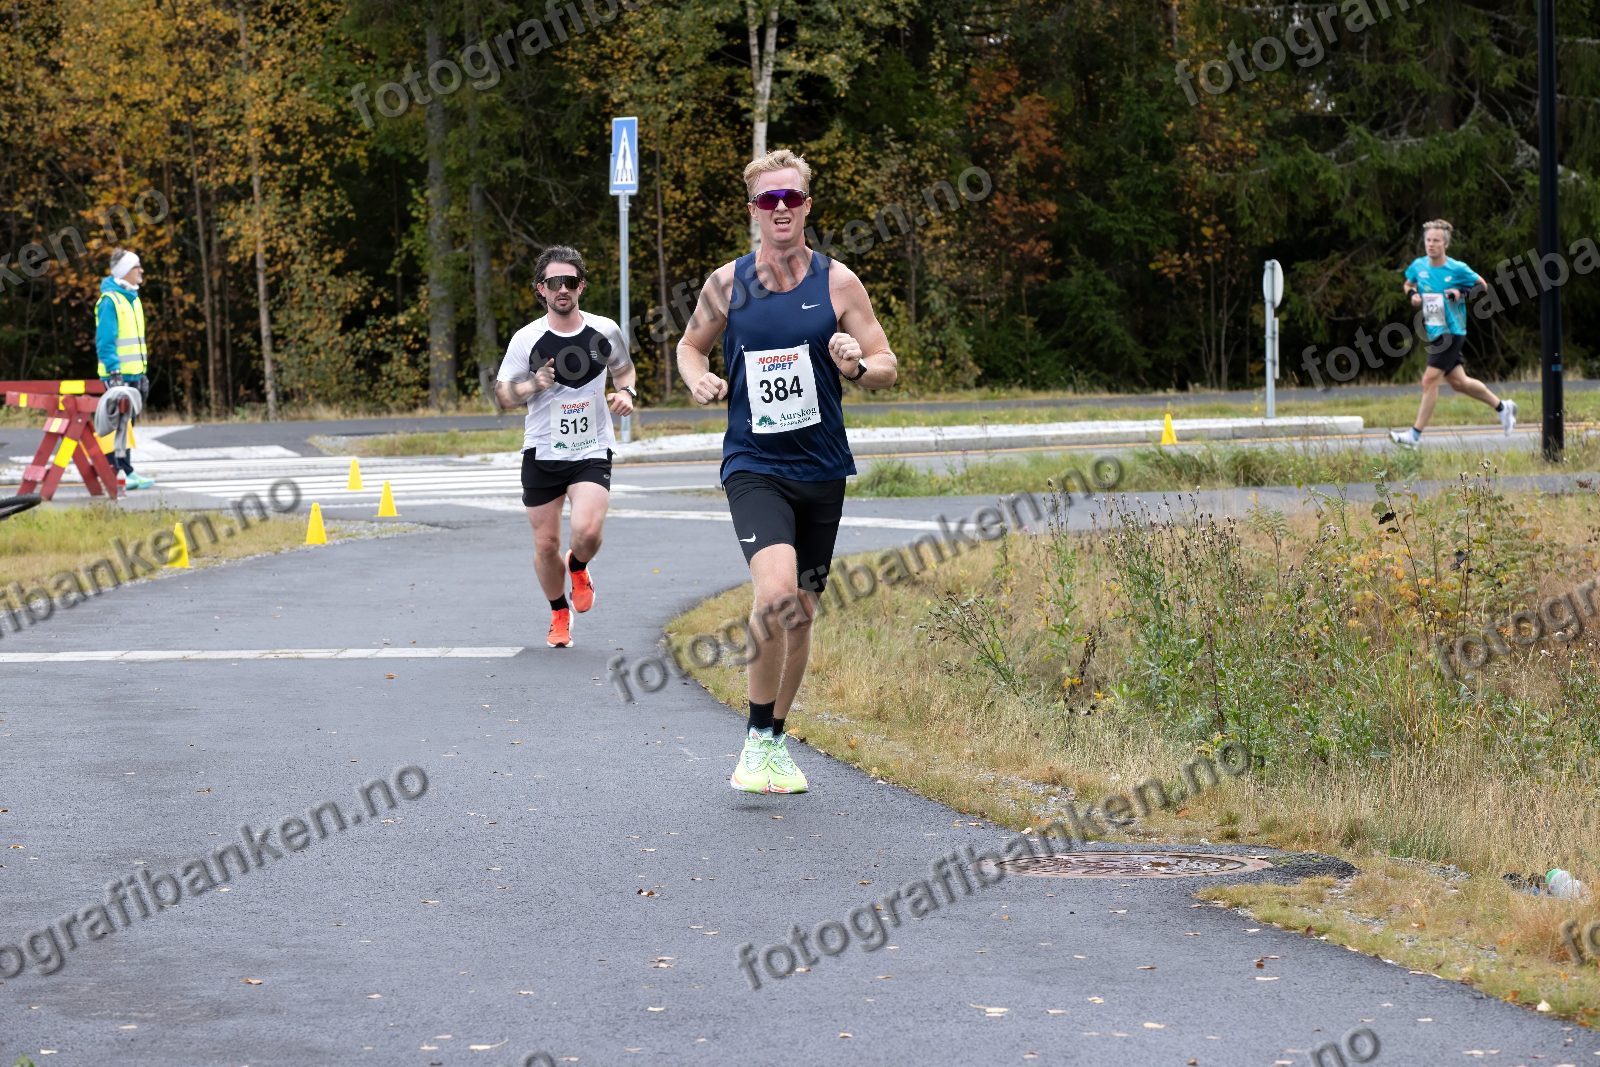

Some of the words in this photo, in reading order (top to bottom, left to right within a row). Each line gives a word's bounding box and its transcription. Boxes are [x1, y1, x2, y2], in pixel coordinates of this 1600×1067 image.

[757, 353, 799, 364] NORGES
[762, 362, 793, 372] LØPET
[760, 375, 803, 403] 384
[560, 416, 589, 435] 513
